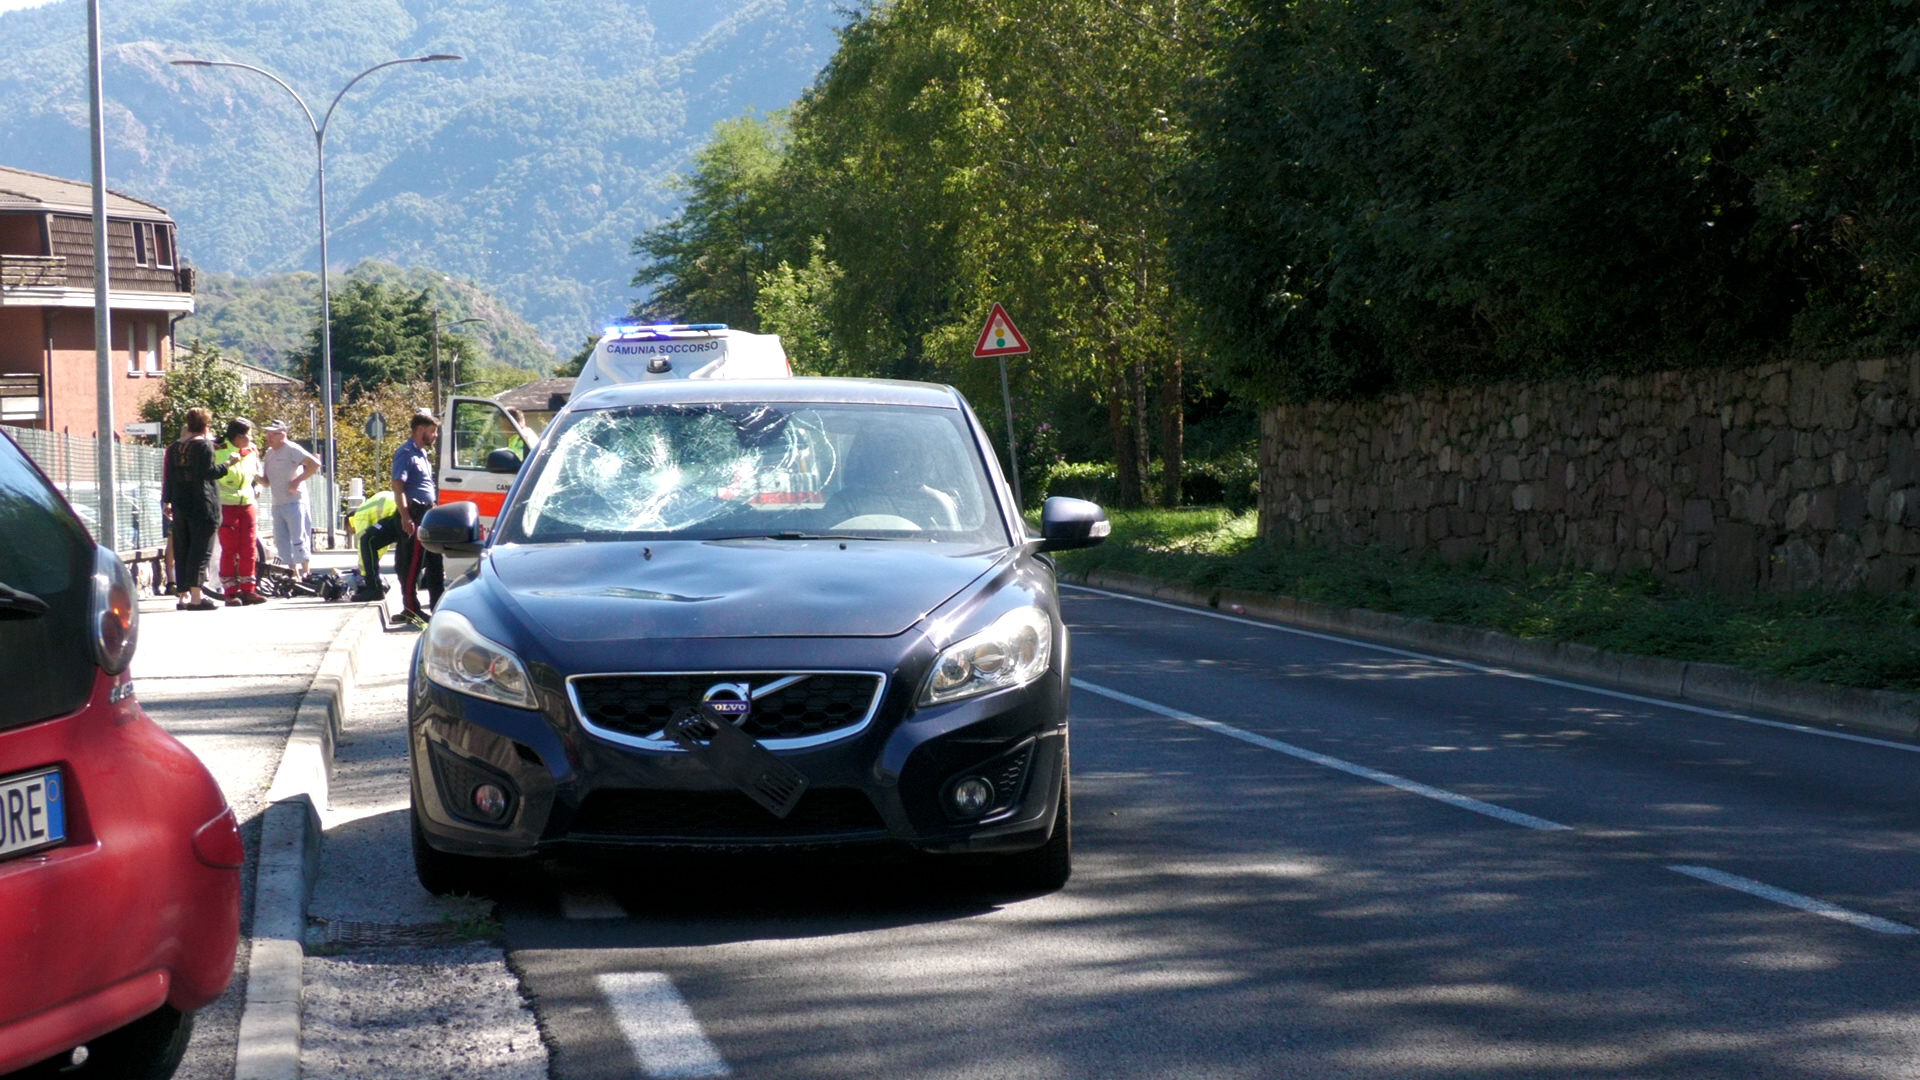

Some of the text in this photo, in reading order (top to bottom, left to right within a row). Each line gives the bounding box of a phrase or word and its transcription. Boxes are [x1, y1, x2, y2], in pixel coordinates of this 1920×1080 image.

[606, 341, 718, 355] CAMUNIA SOCCORSO
[711, 703, 747, 712] OLVO
